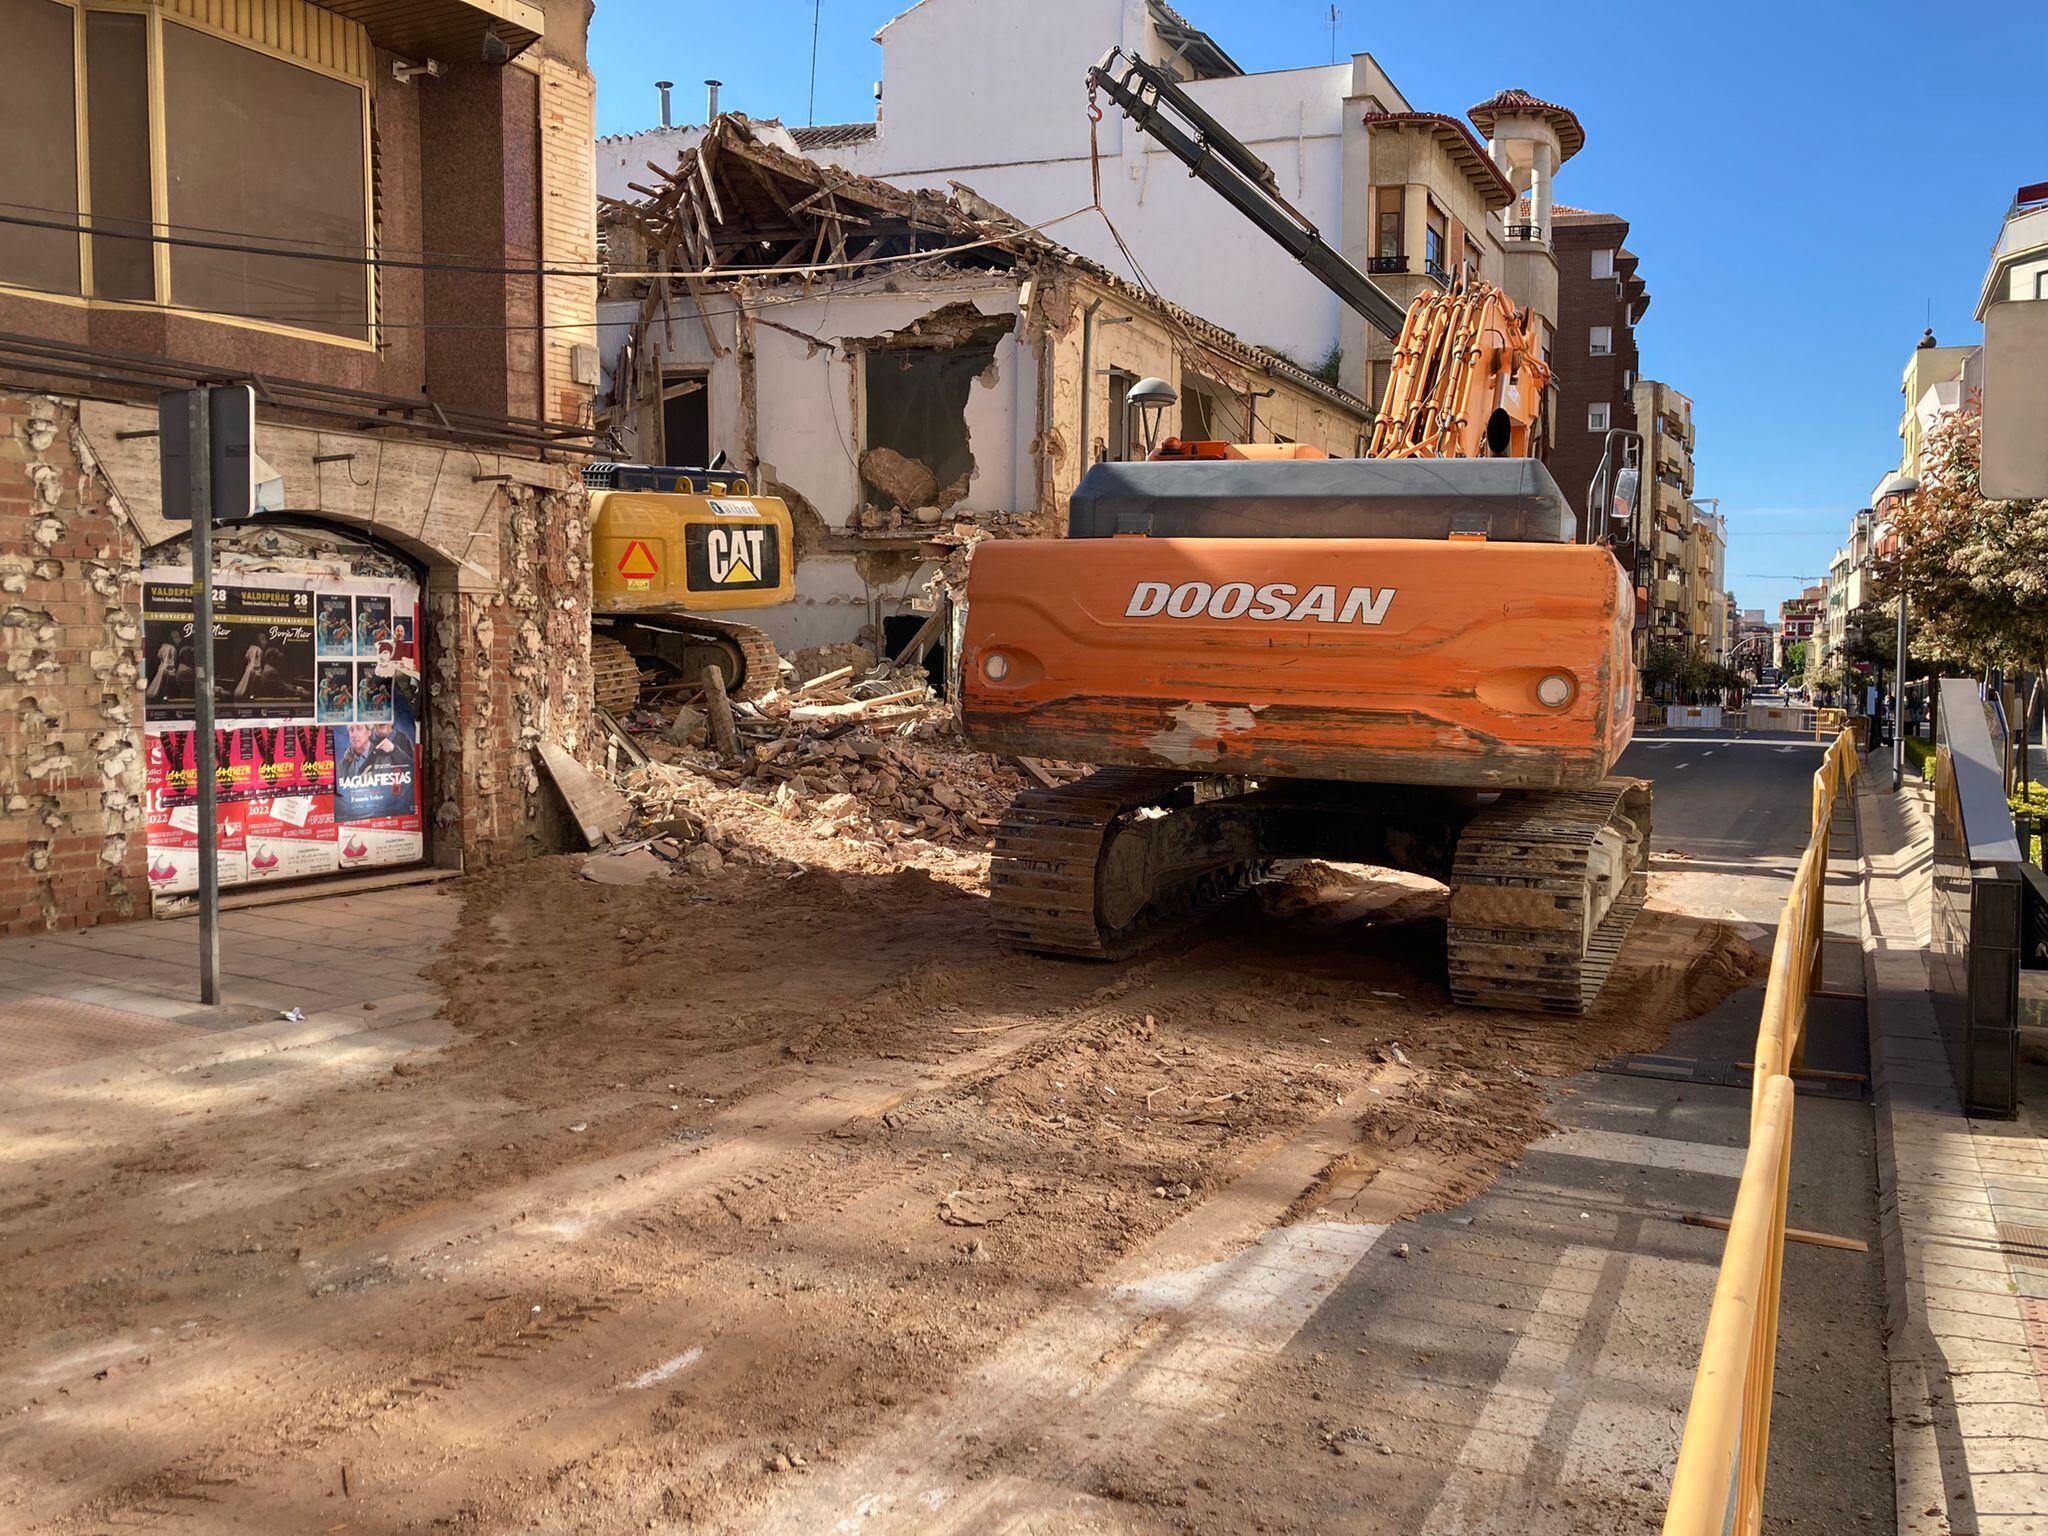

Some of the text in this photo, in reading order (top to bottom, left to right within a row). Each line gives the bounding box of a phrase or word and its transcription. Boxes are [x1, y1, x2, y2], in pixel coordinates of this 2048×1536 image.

[707, 529, 764, 583] CAT
[212, 590, 227, 601] 28
[241, 591, 290, 602] VALDEPEÑAS
[293, 593, 308, 606] 28
[1124, 581, 1397, 625] DOOSAN
[248, 805, 270, 816] 2022
